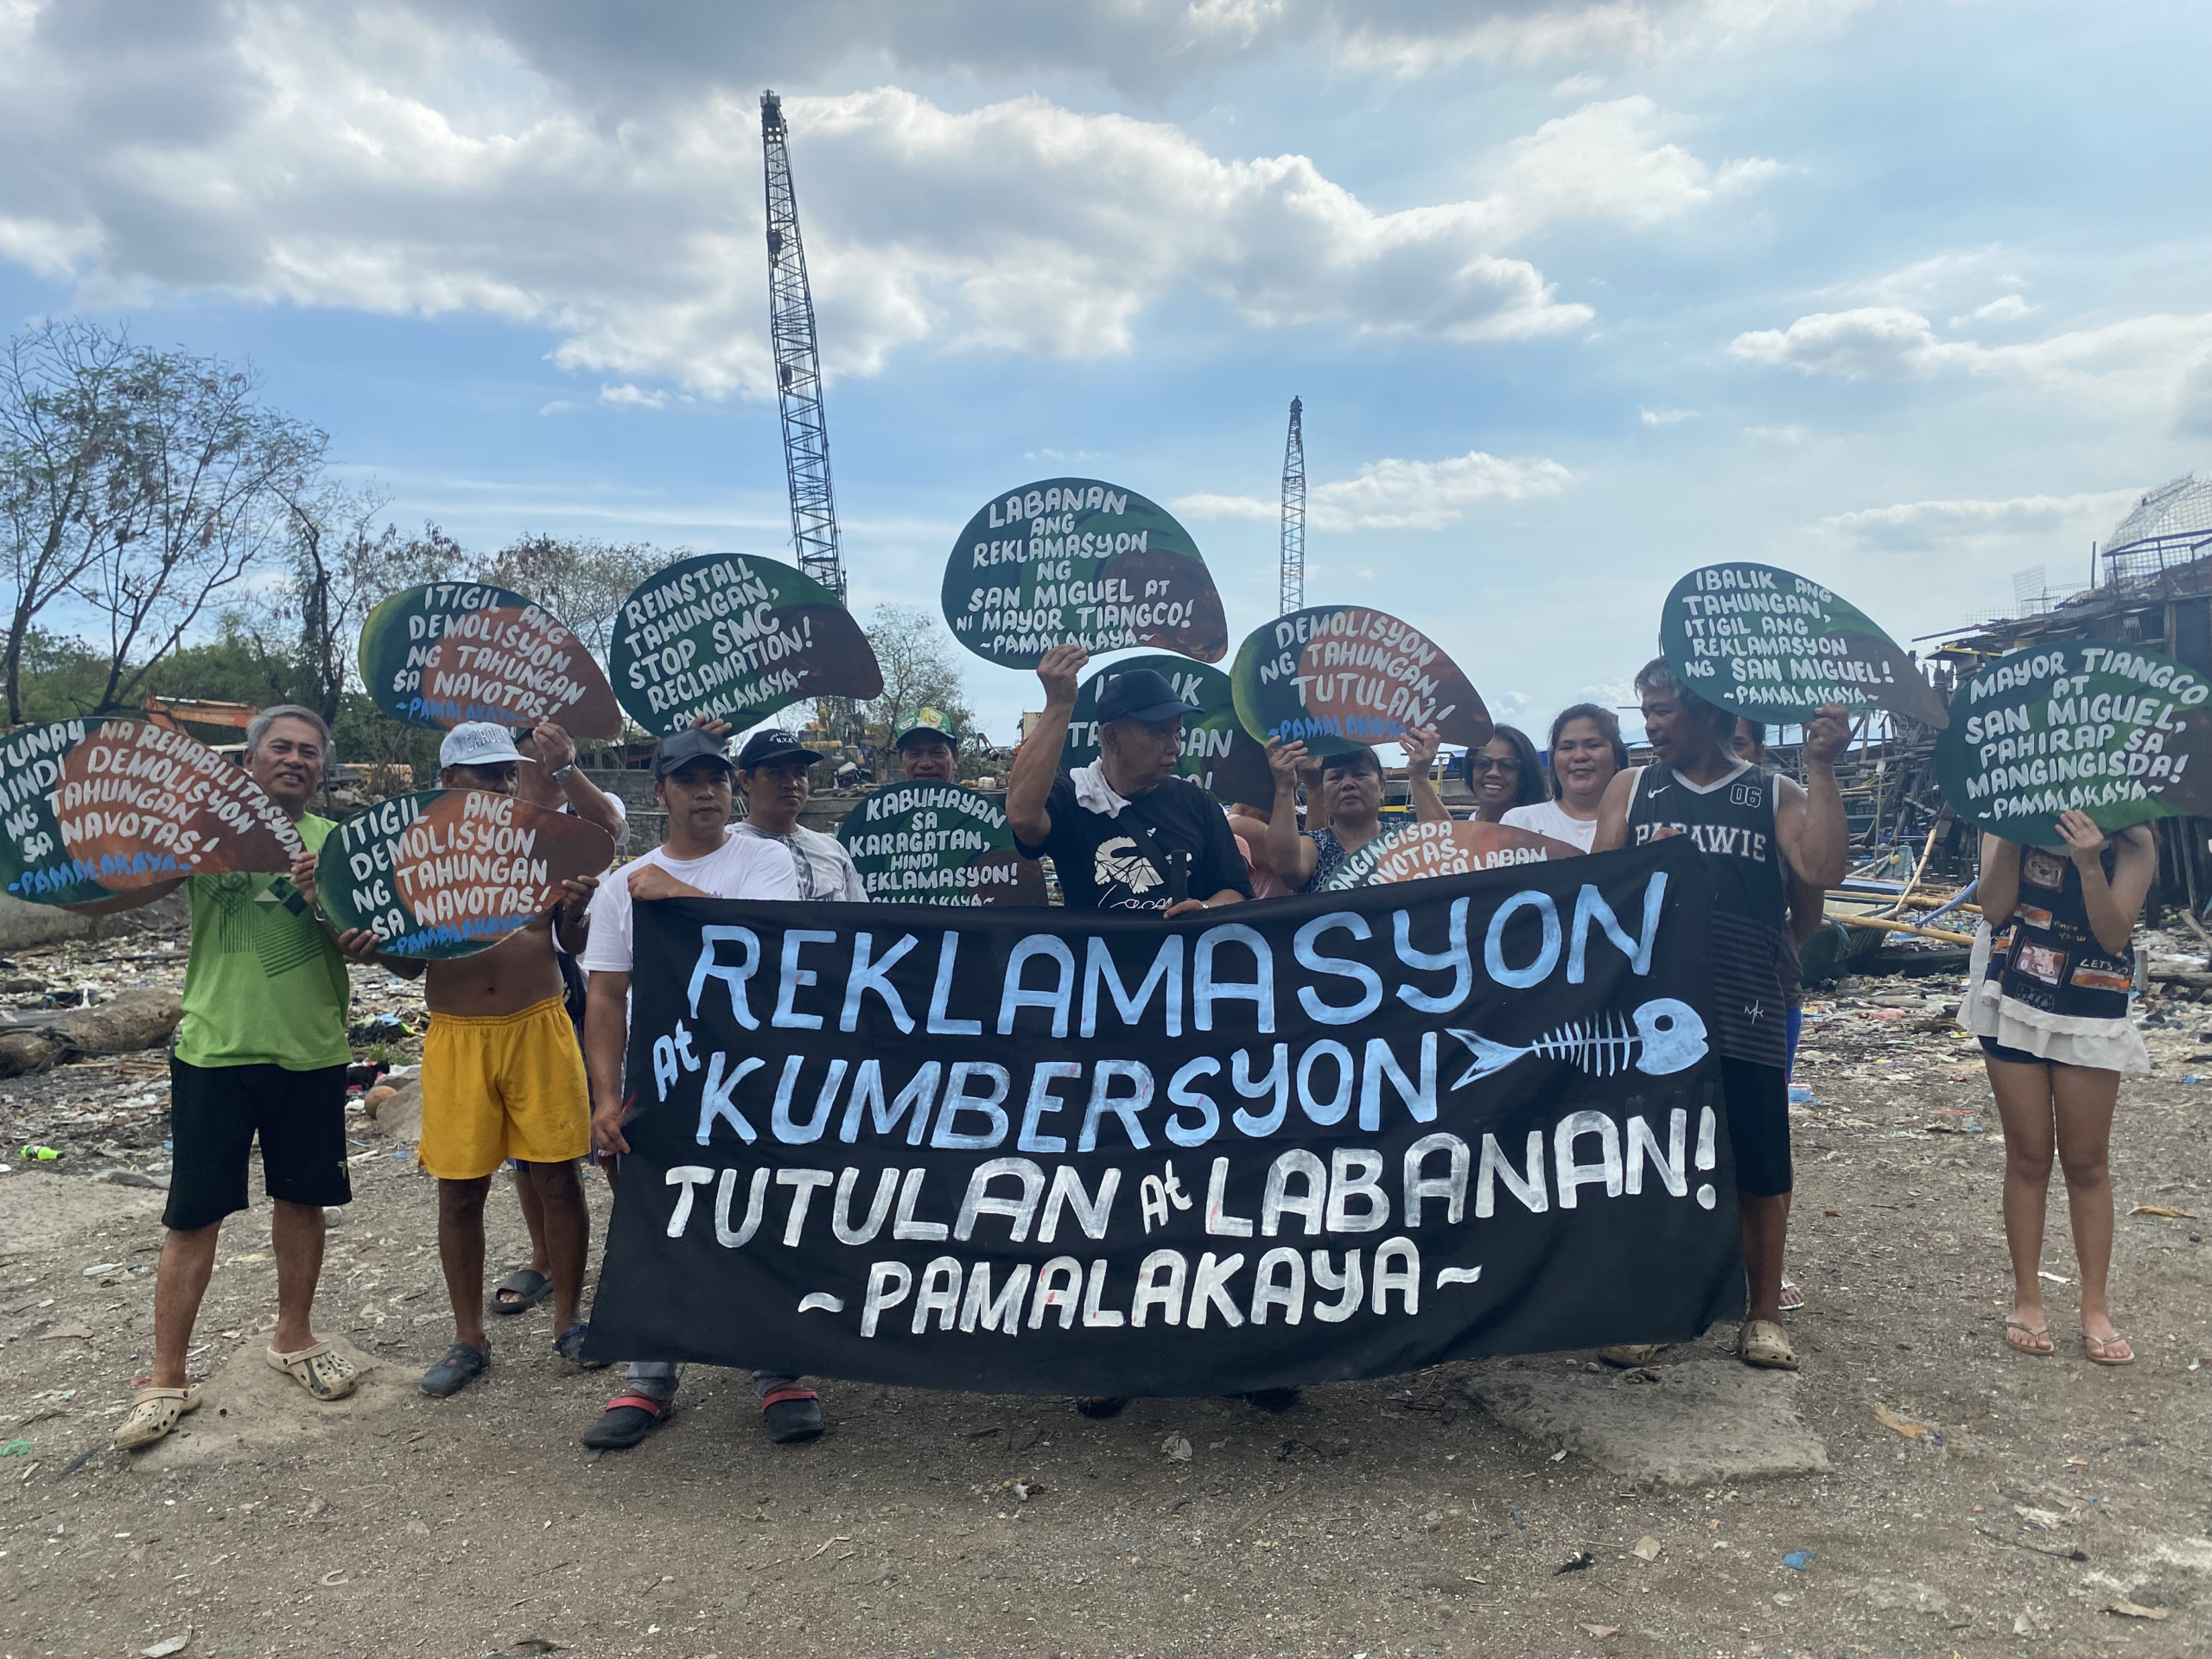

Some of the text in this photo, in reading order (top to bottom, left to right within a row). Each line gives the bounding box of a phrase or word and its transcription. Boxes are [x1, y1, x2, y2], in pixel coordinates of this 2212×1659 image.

[988, 486, 1128, 529] LABANAN
[1030, 513, 1075, 537] ANG
[973, 531, 1147, 569] REKLAMASYON
[1037, 560, 1071, 582] NG
[626, 557, 754, 630] REINSTALL
[968, 579, 1171, 613] SAN MIGUEL AT
[1682, 594, 1832, 623] TAHUNGAN,
[1696, 569, 1832, 603] IBALIK ANG
[425, 585, 569, 645] ITIGIL ANG
[625, 577, 779, 658] TAHUNGAN,
[957, 599, 1194, 633] NI MAYOR TIANGCO!
[1275, 611, 1437, 667] DEMOLISYON
[1685, 617, 1808, 638] ITIGIL ANG
[409, 614, 572, 672] DEMOLISYON
[629, 602, 779, 690] STOP SMC
[647, 615, 813, 715] RECLAMATION!
[1260, 652, 1295, 684] NG
[1693, 637, 1847, 657] REKLAMASYON
[393, 670, 563, 722] SA NAVOTAS!
[406, 645, 588, 705] NG TAHUNGAN
[1685, 658, 1894, 683] NG SAN MIGUEL!
[1970, 648, 2209, 704] MAYOR TIANGCO
[2053, 675, 2089, 699] AT
[1290, 673, 1455, 731] TUTULAN!
[1965, 693, 2187, 744] SAN MIGUEL,
[1980, 724, 2164, 769] PAHIRAP SA
[87, 747, 256, 835] DEMOLISYON
[99, 721, 135, 741] NA
[137, 724, 304, 860] REHABILITASYON
[1730, 783, 1762, 808] 06
[1966, 751, 2189, 800] MANGINGISDA!
[5, 778, 200, 842] NG TAHUNGAN
[340, 792, 515, 854] ITIGIL ANG
[866, 787, 1007, 830] KABUHAYAN
[912, 811, 938, 831] SA
[23, 811, 219, 864] SA NAVOTAS!
[350, 822, 537, 882] DEMOLISYON
[849, 829, 990, 859] KARAGATAN,
[891, 852, 938, 870] HINDI
[1363, 838, 1468, 887] AVOTAS,
[352, 854, 548, 913] NG TAHUNGAN
[372, 886, 551, 942] SA NAVOTAS!
[688, 872, 1668, 1038] REKLAMASYON
[696, 1032, 1437, 1152] KUMBERSYON
[665, 1158, 1122, 1248] TUTULAN
[1205, 1106, 1717, 1237] LABANAN!
